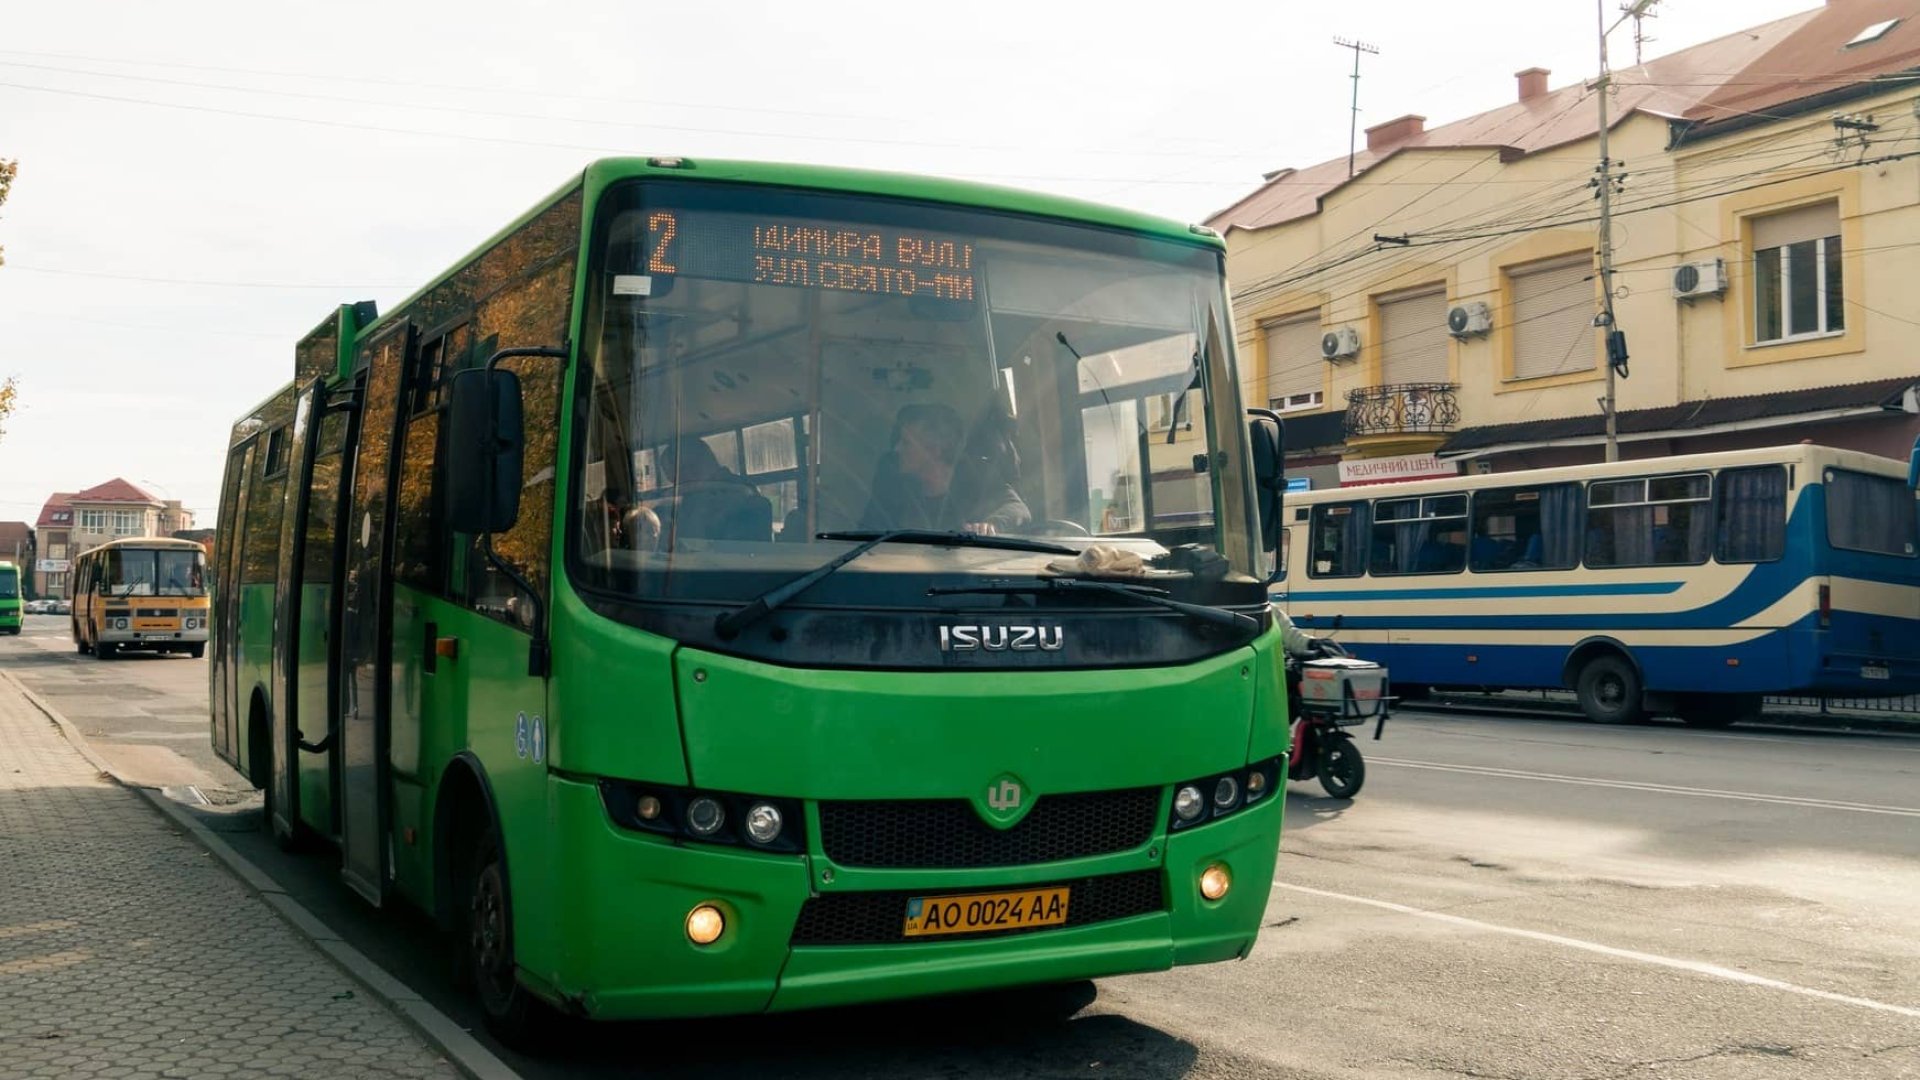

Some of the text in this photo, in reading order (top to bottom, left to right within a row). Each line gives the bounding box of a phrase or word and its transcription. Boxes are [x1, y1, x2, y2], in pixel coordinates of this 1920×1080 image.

[649, 212, 676, 274] 2
[755, 225, 880, 260] ДИМИРА
[1346, 459, 1408, 477] МЕДИЧНИЙ
[939, 625, 1064, 651] ISUZU
[923, 893, 1062, 930] AO 0024 AA
